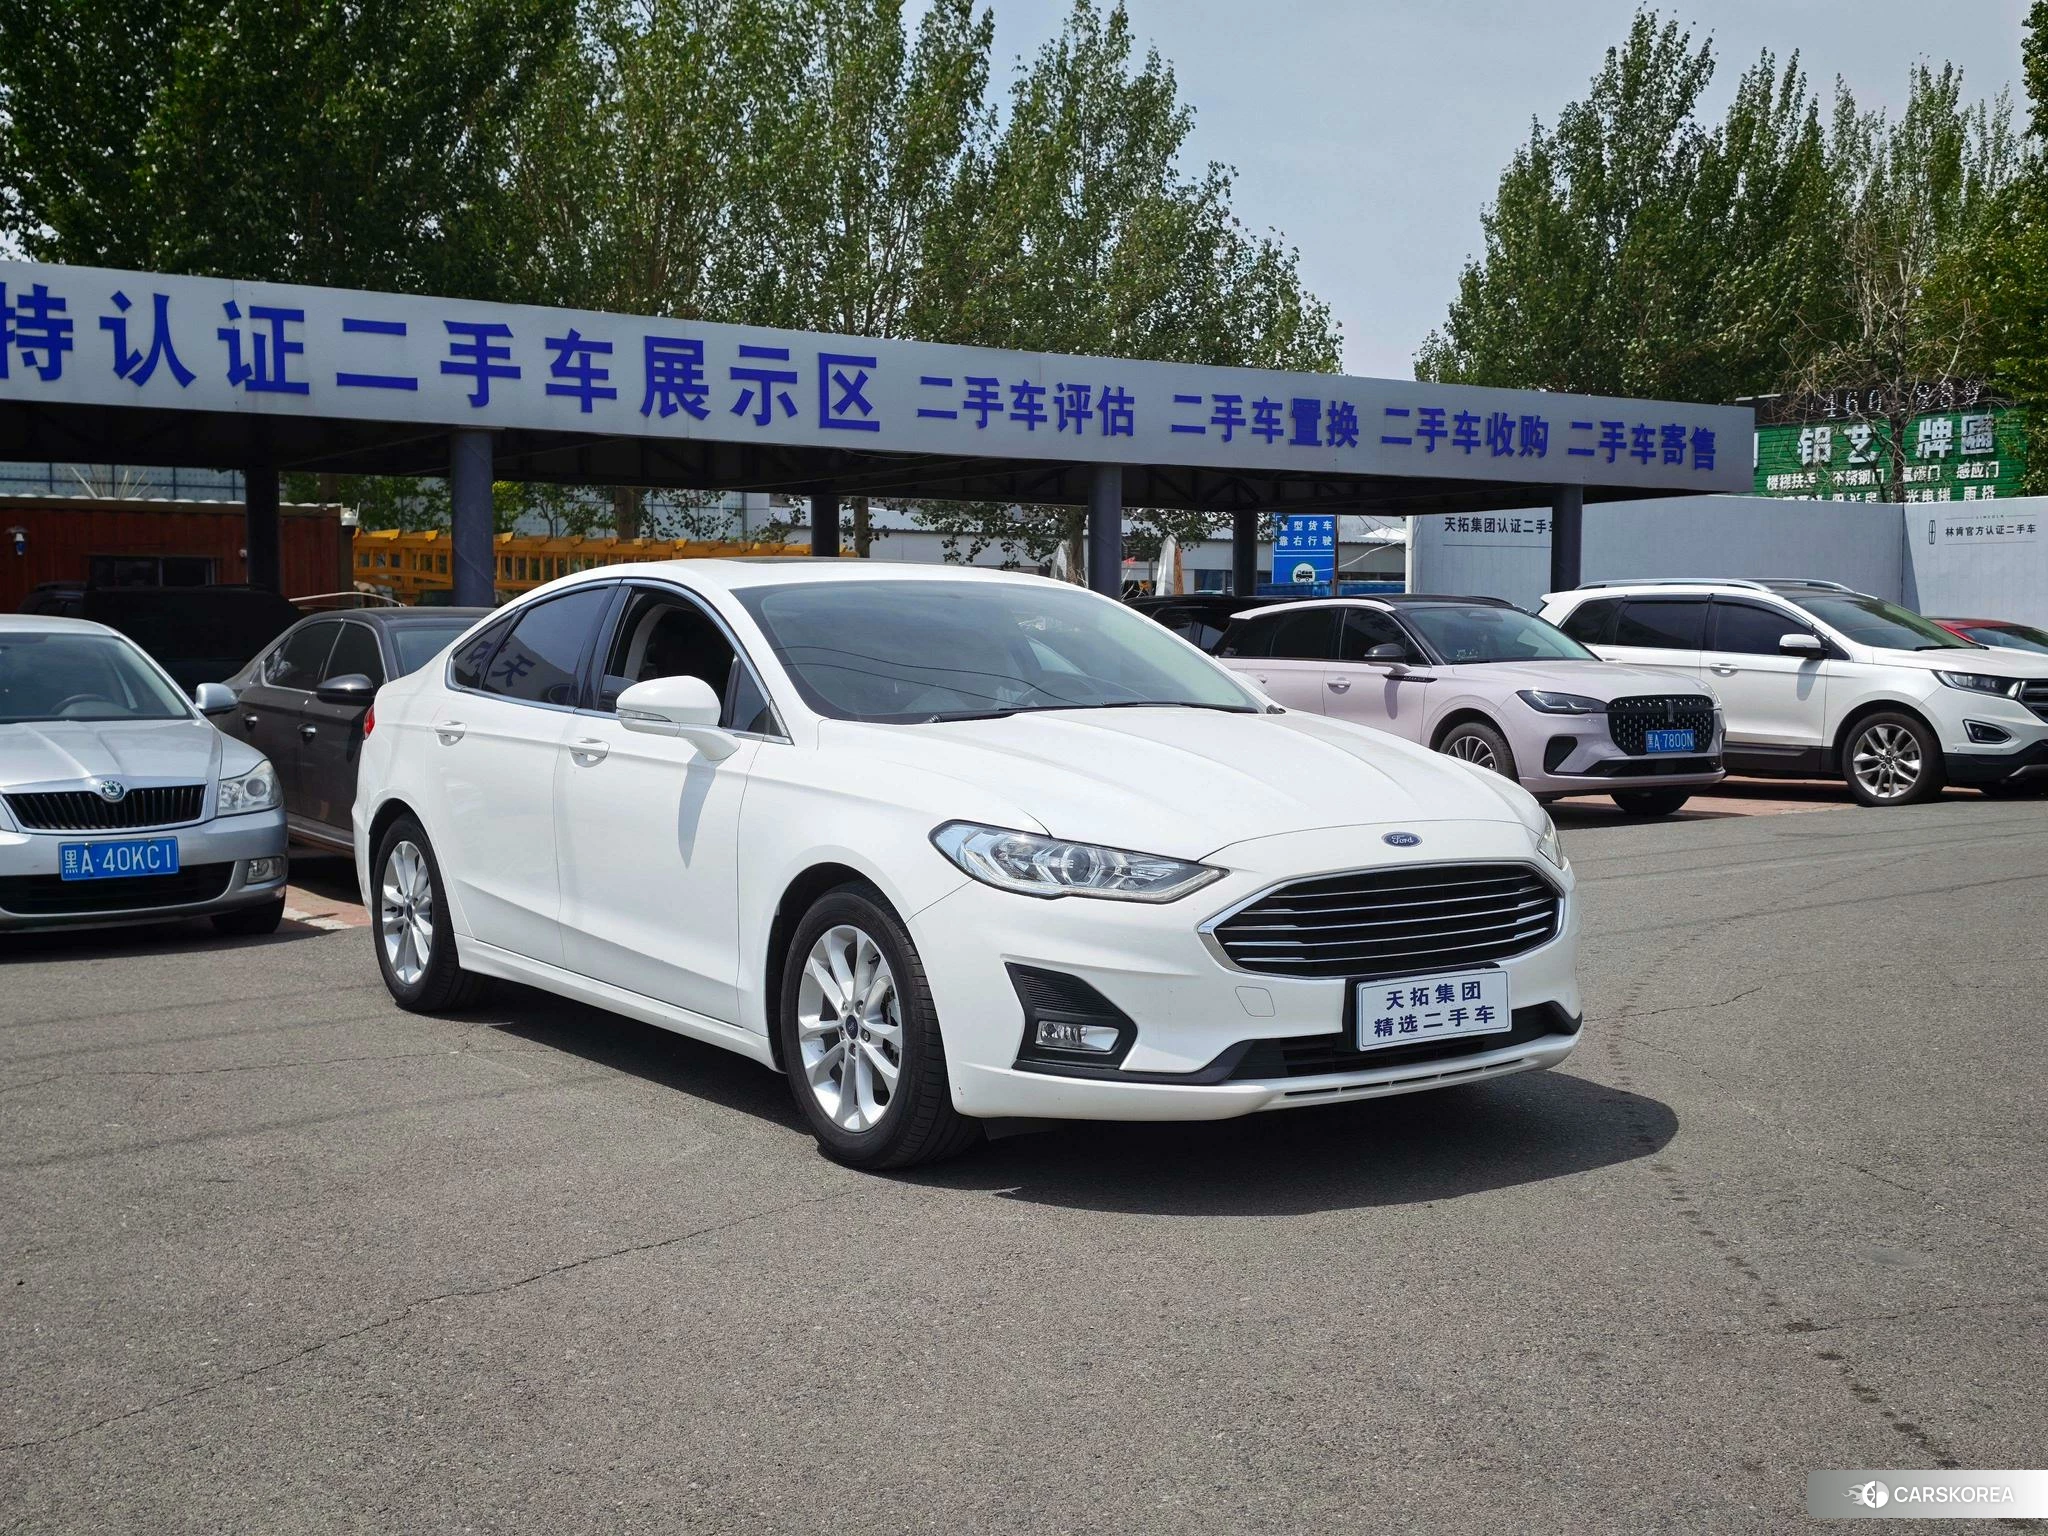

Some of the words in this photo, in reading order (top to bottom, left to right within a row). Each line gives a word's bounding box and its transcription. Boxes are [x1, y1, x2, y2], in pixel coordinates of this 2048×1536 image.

[0, 282, 881, 434] 特认证二手车展示区
[917, 376, 1136, 437] 二手车评估
[1171, 394, 1360, 447] 二手车置换
[1381, 406, 1550, 457] 二手车收购
[1568, 420, 1716, 471] 二手车寄售
[1956, 460, 1999, 479] 感应门
[1444, 516, 1553, 535] 天拓集团认证二手
[1945, 523, 2037, 537] 林肯官方认证二手车
[1279, 535, 1333, 547] 靠右行驶
[1391, 834, 1414, 845] Ford
[1386, 980, 1481, 1011] 天拓集团
[1374, 1005, 1496, 1038] 精选二手车
